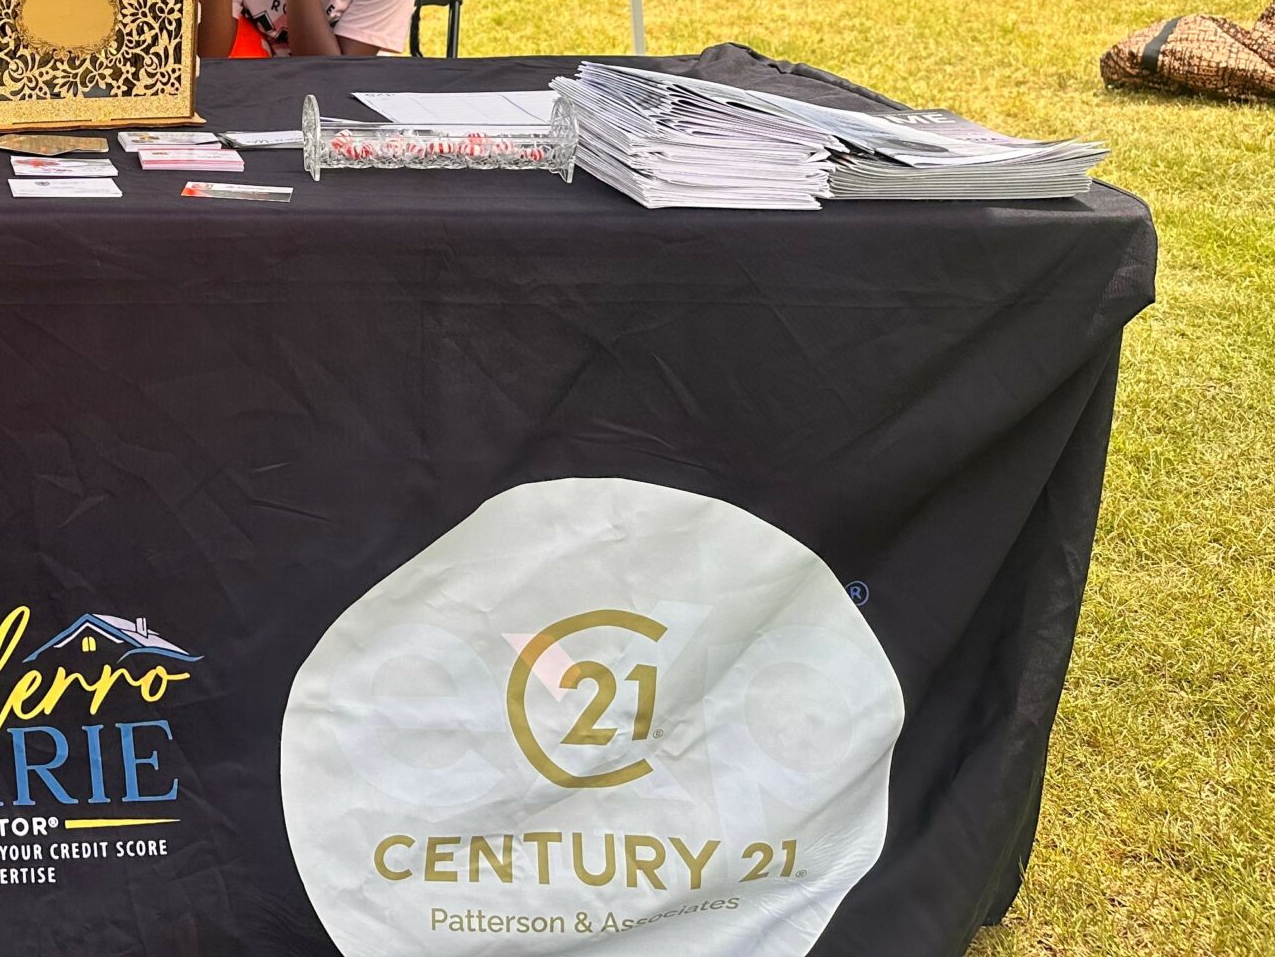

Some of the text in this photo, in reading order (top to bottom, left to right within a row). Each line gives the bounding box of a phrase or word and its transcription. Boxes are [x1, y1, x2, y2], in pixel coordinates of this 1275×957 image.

[0, 843, 43, 861] YOUR
[50, 841, 108, 860] CREDIT
[116, 839, 168, 857] SCORE
[373, 831, 721, 890] CENTURY
[431, 896, 740, 934] Patterson & Associates
